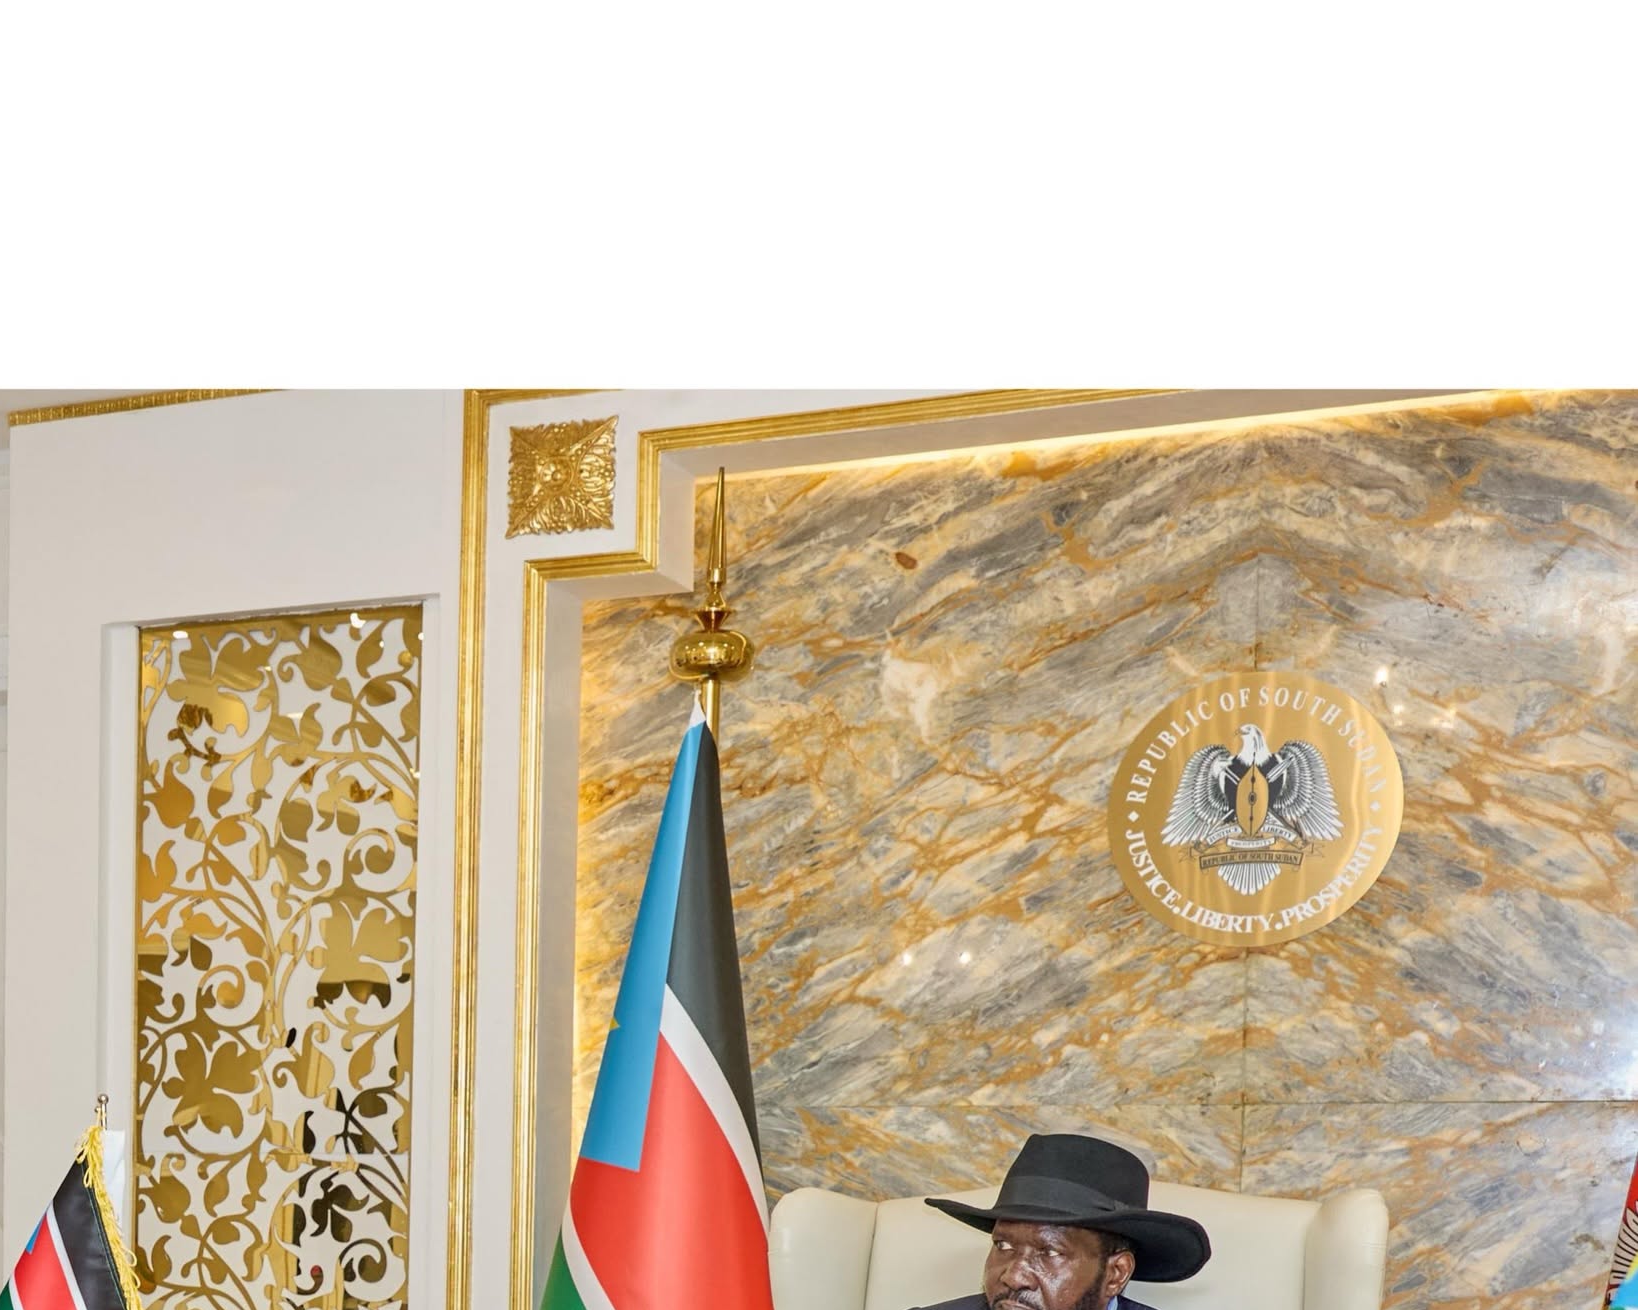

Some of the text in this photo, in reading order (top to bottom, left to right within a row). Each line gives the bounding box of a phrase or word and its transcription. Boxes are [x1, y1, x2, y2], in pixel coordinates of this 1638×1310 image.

[1126, 686, 1388, 804] REPUBLIC OF SOUTH SUDAN
[1248, 852, 1274, 861] SOUTH
[1275, 853, 1299, 862] SUDAN
[1282, 823, 1383, 927] PROSPERITY
